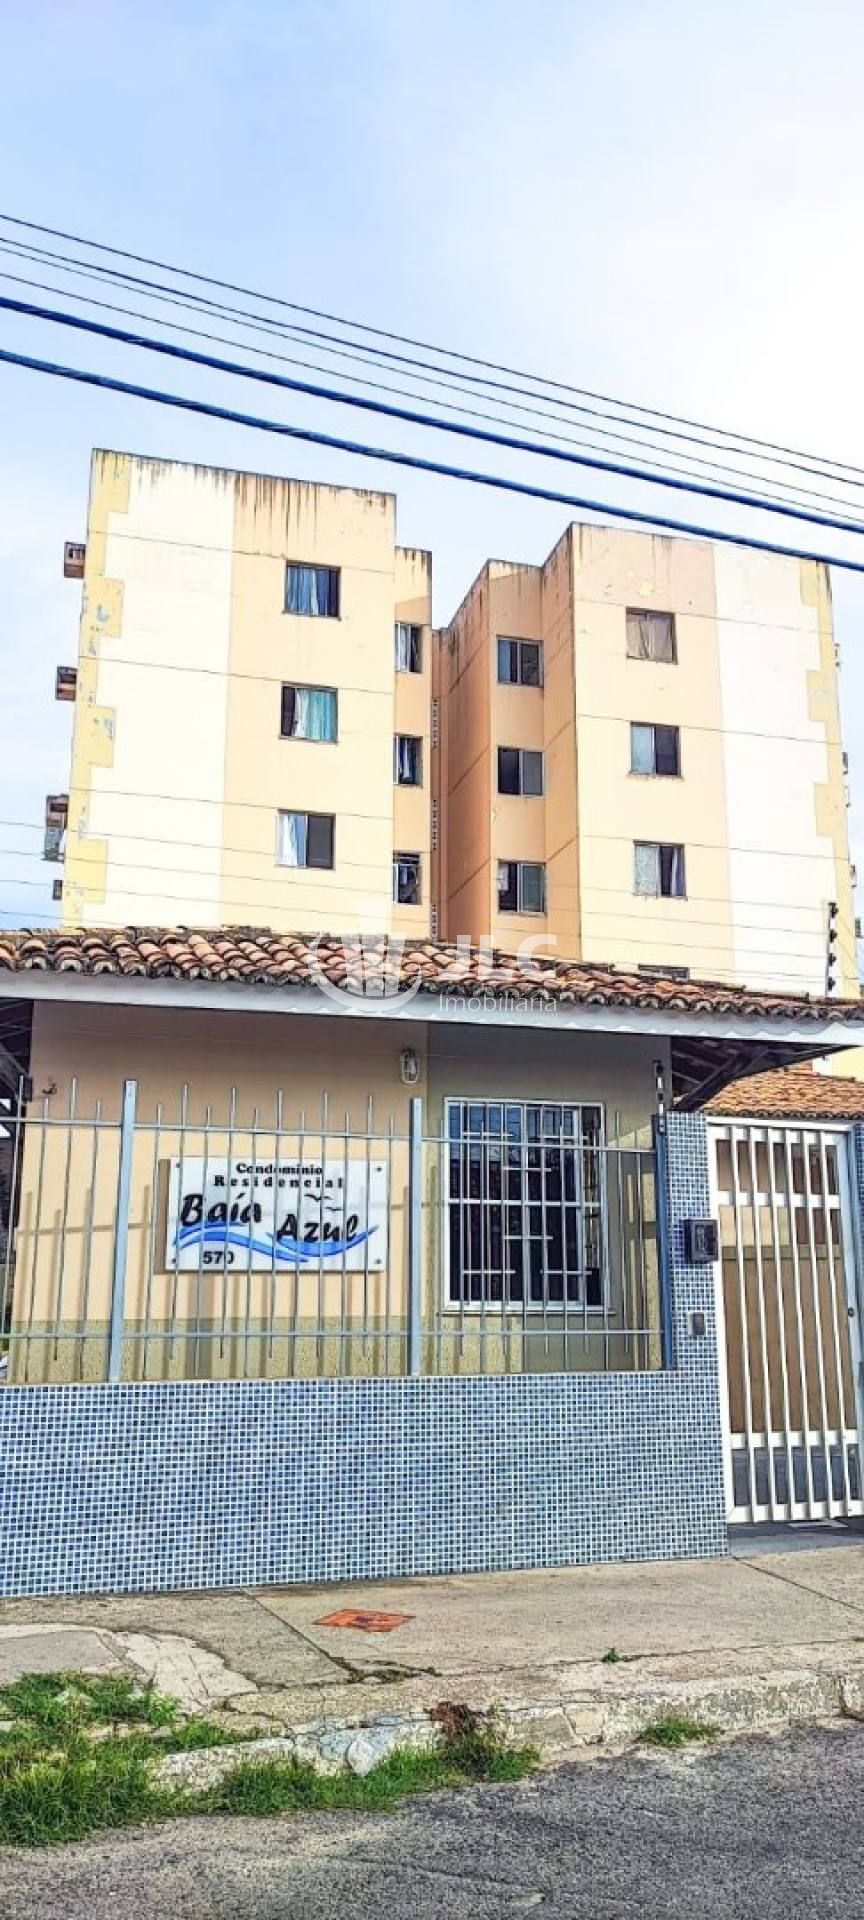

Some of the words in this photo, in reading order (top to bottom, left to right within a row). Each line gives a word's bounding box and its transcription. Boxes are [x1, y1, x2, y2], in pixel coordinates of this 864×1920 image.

[213, 1175, 344, 1188] Residencial
[180, 1192, 263, 1227] Baía
[276, 1213, 359, 1243] Azul
[202, 1250, 234, 1265] 570
